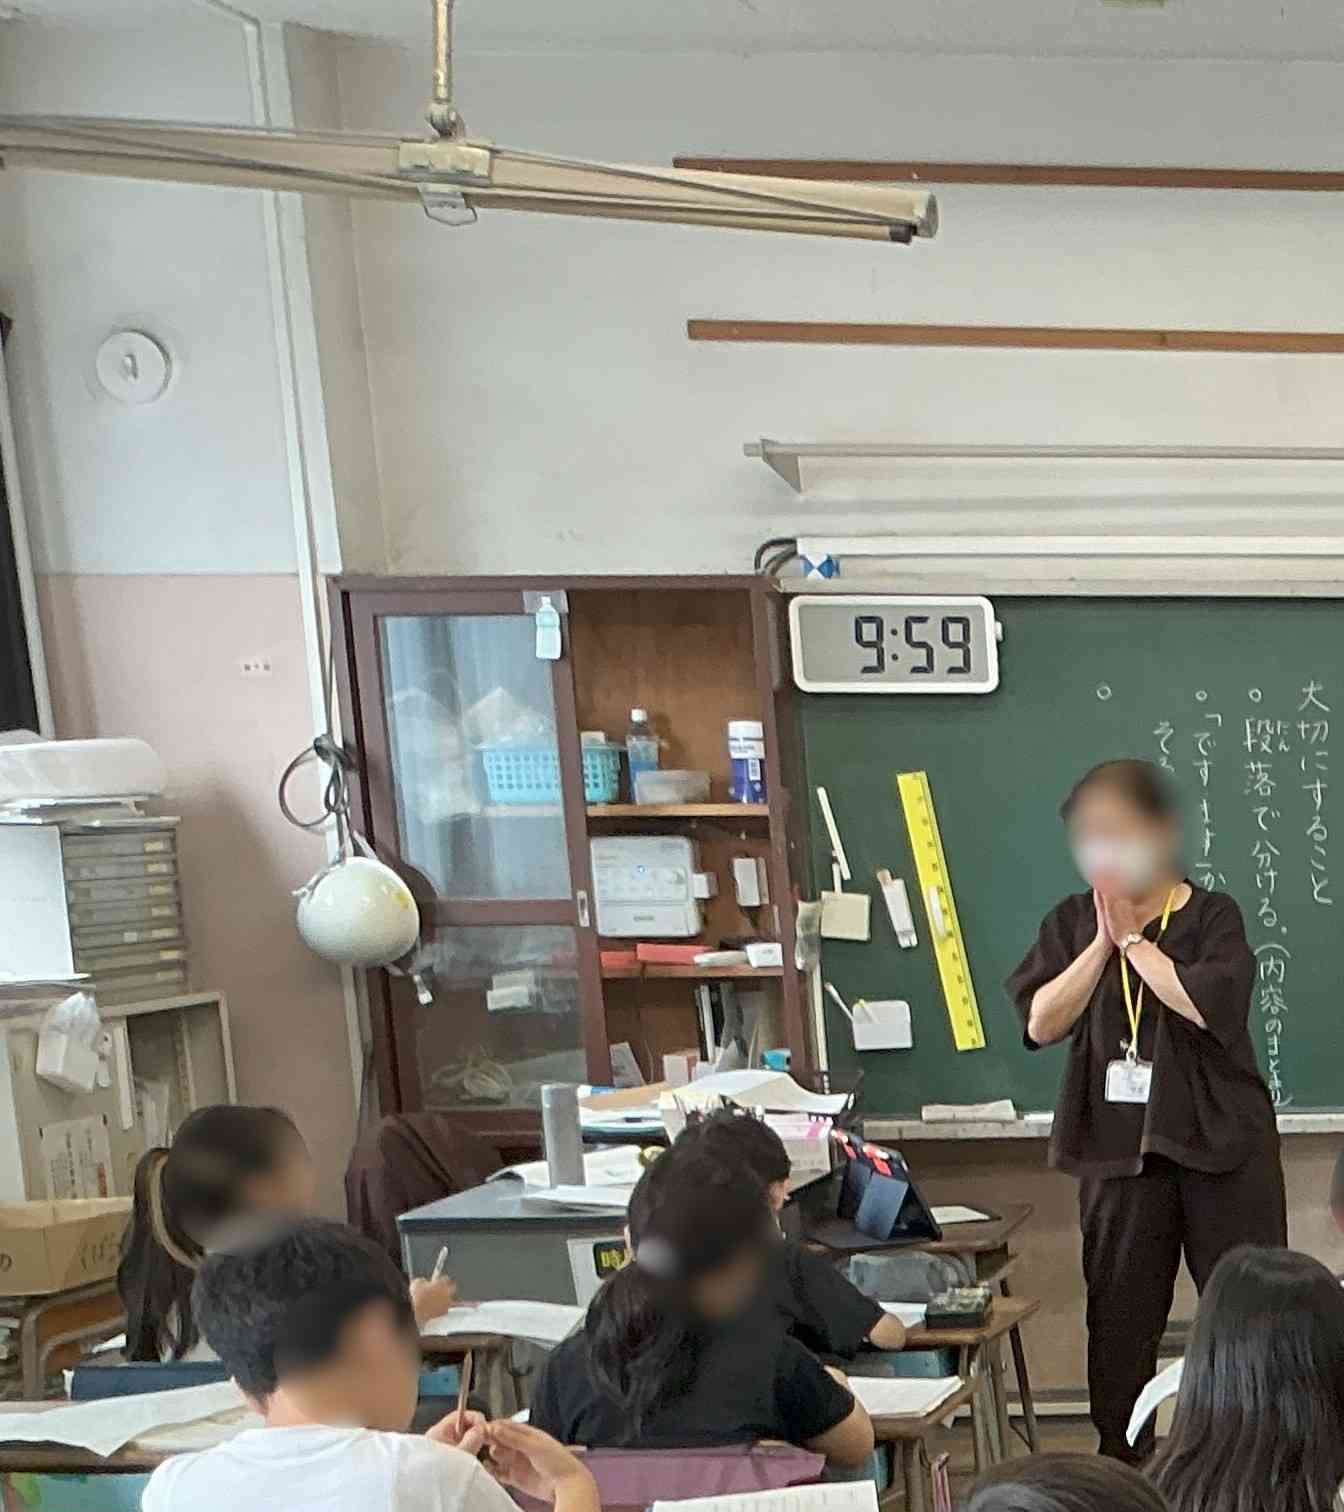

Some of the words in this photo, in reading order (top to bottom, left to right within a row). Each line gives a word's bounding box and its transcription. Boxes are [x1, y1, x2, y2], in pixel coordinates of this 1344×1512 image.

[855, 616, 971, 674] 9:59
[1296, 680, 1333, 904] 大切にすること
